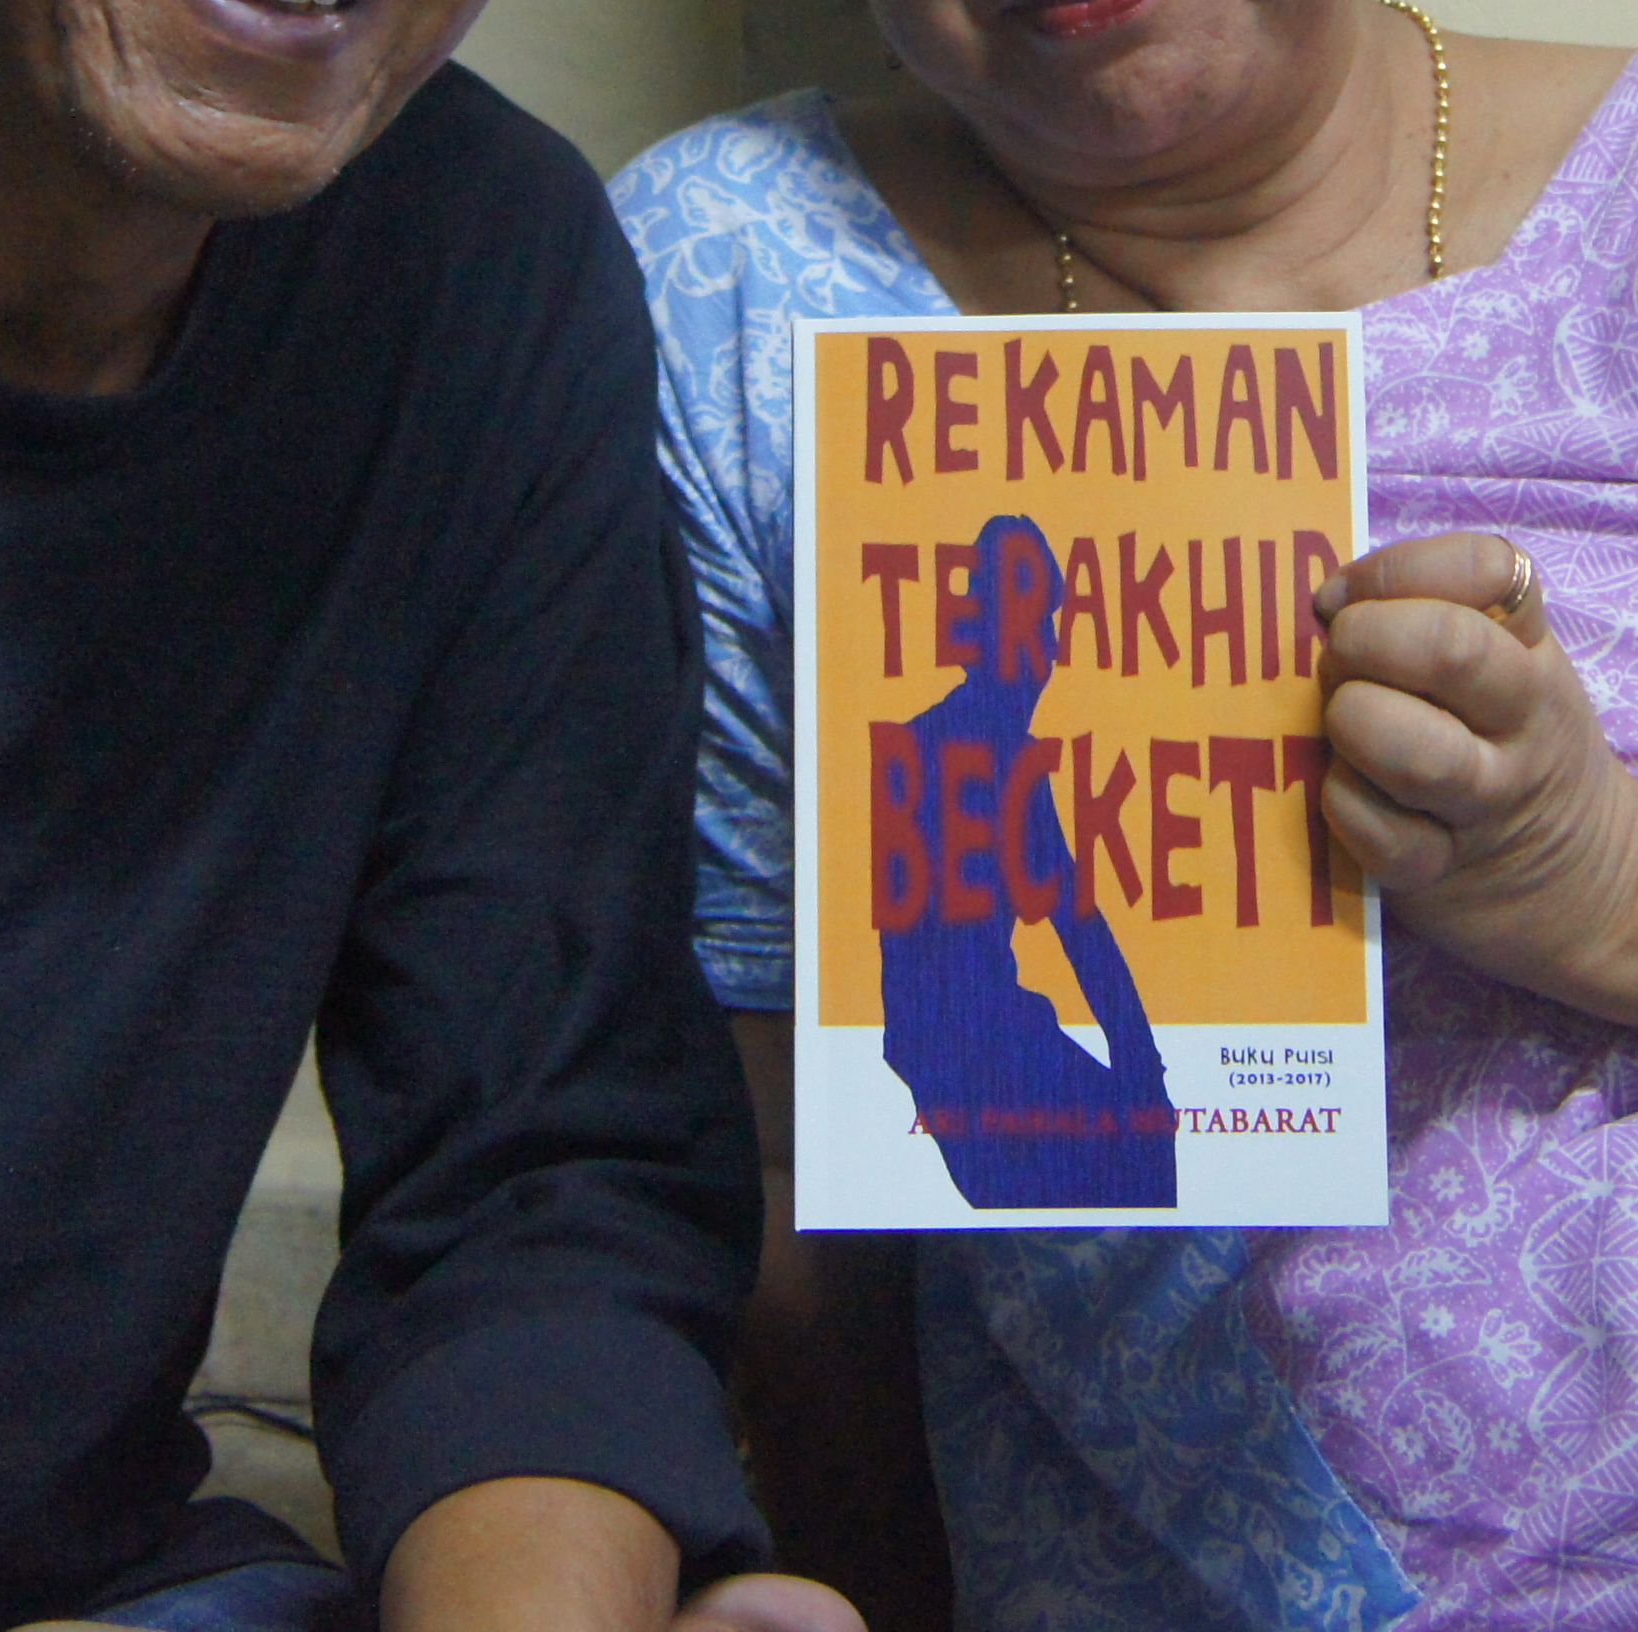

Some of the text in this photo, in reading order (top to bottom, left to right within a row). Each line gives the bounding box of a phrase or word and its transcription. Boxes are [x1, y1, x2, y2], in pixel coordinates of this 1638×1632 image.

[864, 336, 1339, 486] REKAMAN
[868, 721, 1335, 932] BECKETT
[1228, 1071, 1332, 1089] (2013-2017)
